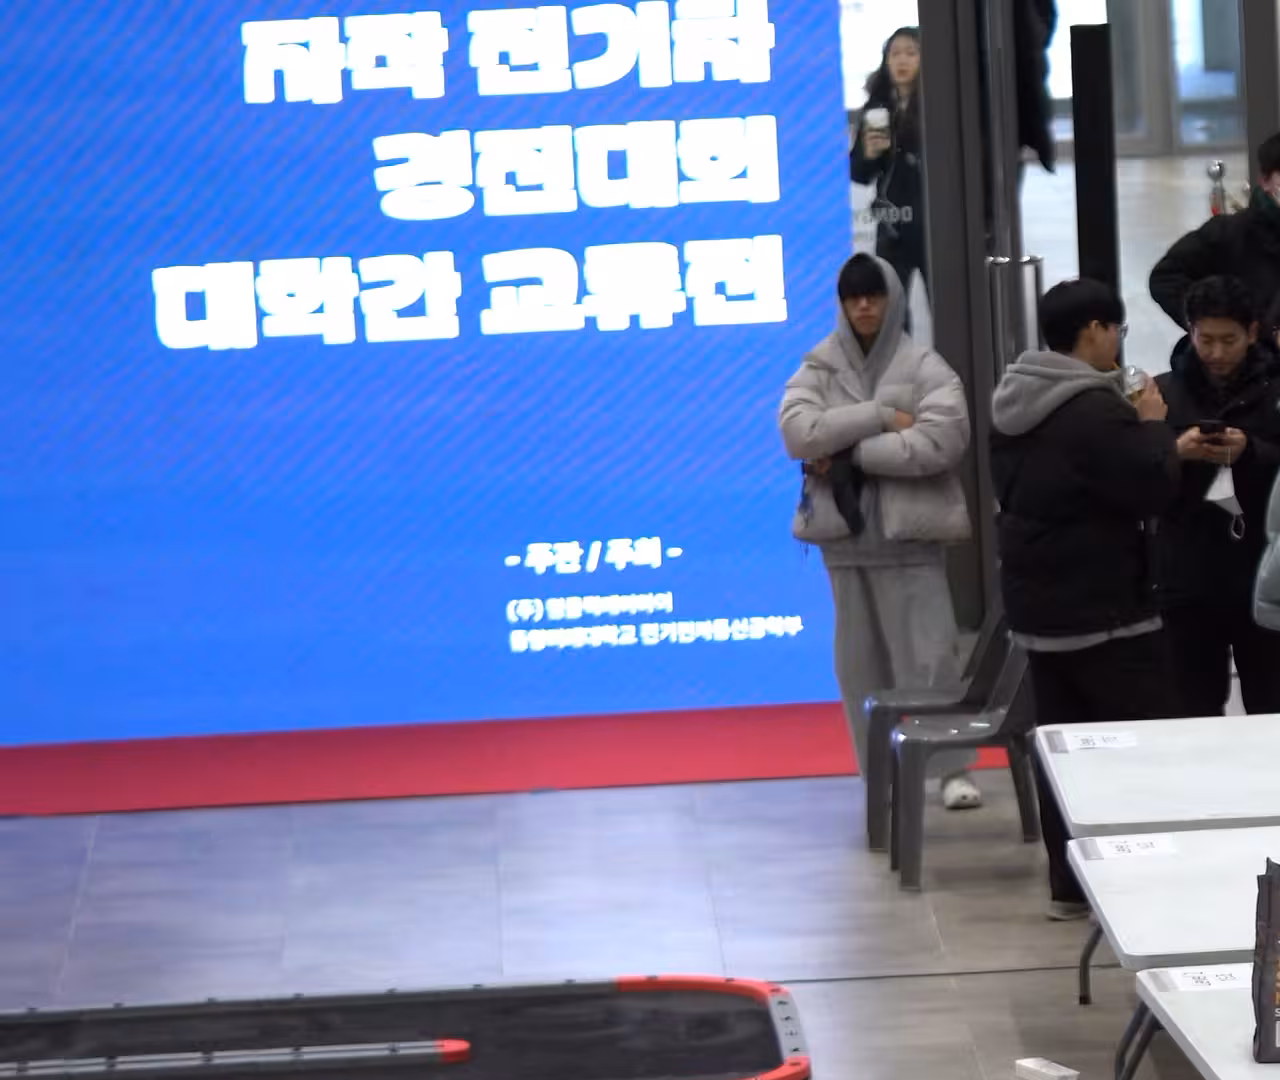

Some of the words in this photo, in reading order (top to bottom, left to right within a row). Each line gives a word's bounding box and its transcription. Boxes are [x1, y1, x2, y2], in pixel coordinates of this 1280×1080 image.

[243, 11, 449, 103] 자작
[469, 0, 775, 94] 전기차
[152, 251, 461, 349] 대학간
[480, 235, 787, 334] 교류전
